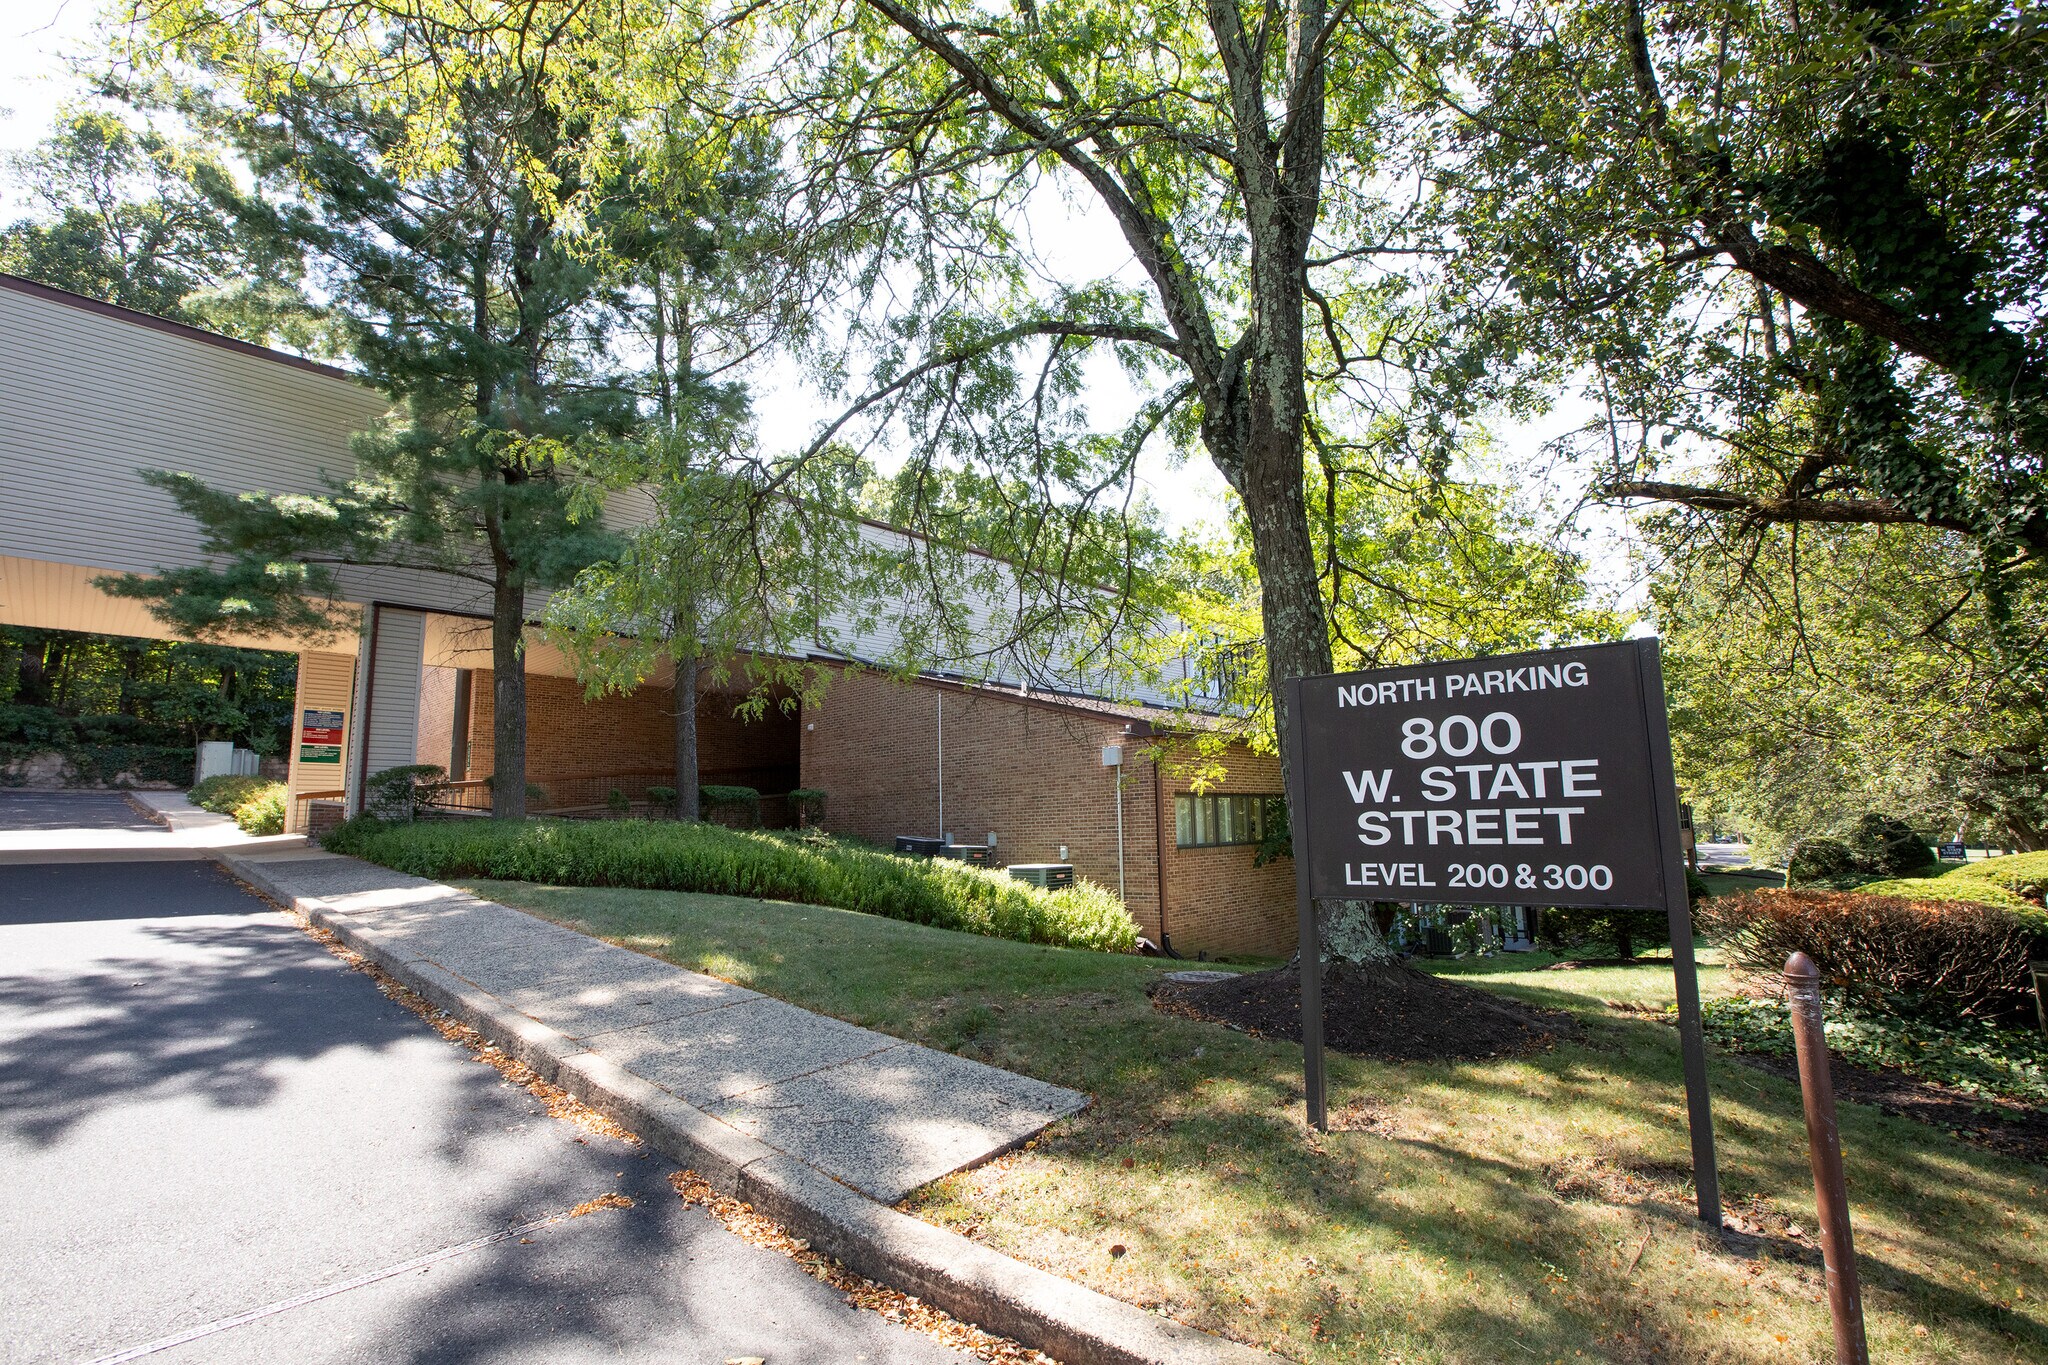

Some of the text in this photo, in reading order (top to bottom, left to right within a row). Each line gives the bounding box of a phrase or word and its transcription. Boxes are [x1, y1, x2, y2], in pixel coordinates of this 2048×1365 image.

[1337, 661, 1589, 708] NORTH PARKING
[1400, 711, 1522, 760] 800
[1341, 758, 1603, 804] W. STATE
[1357, 806, 1586, 846] STREET
[1344, 862, 1614, 891] LEVEL 200 & 300
